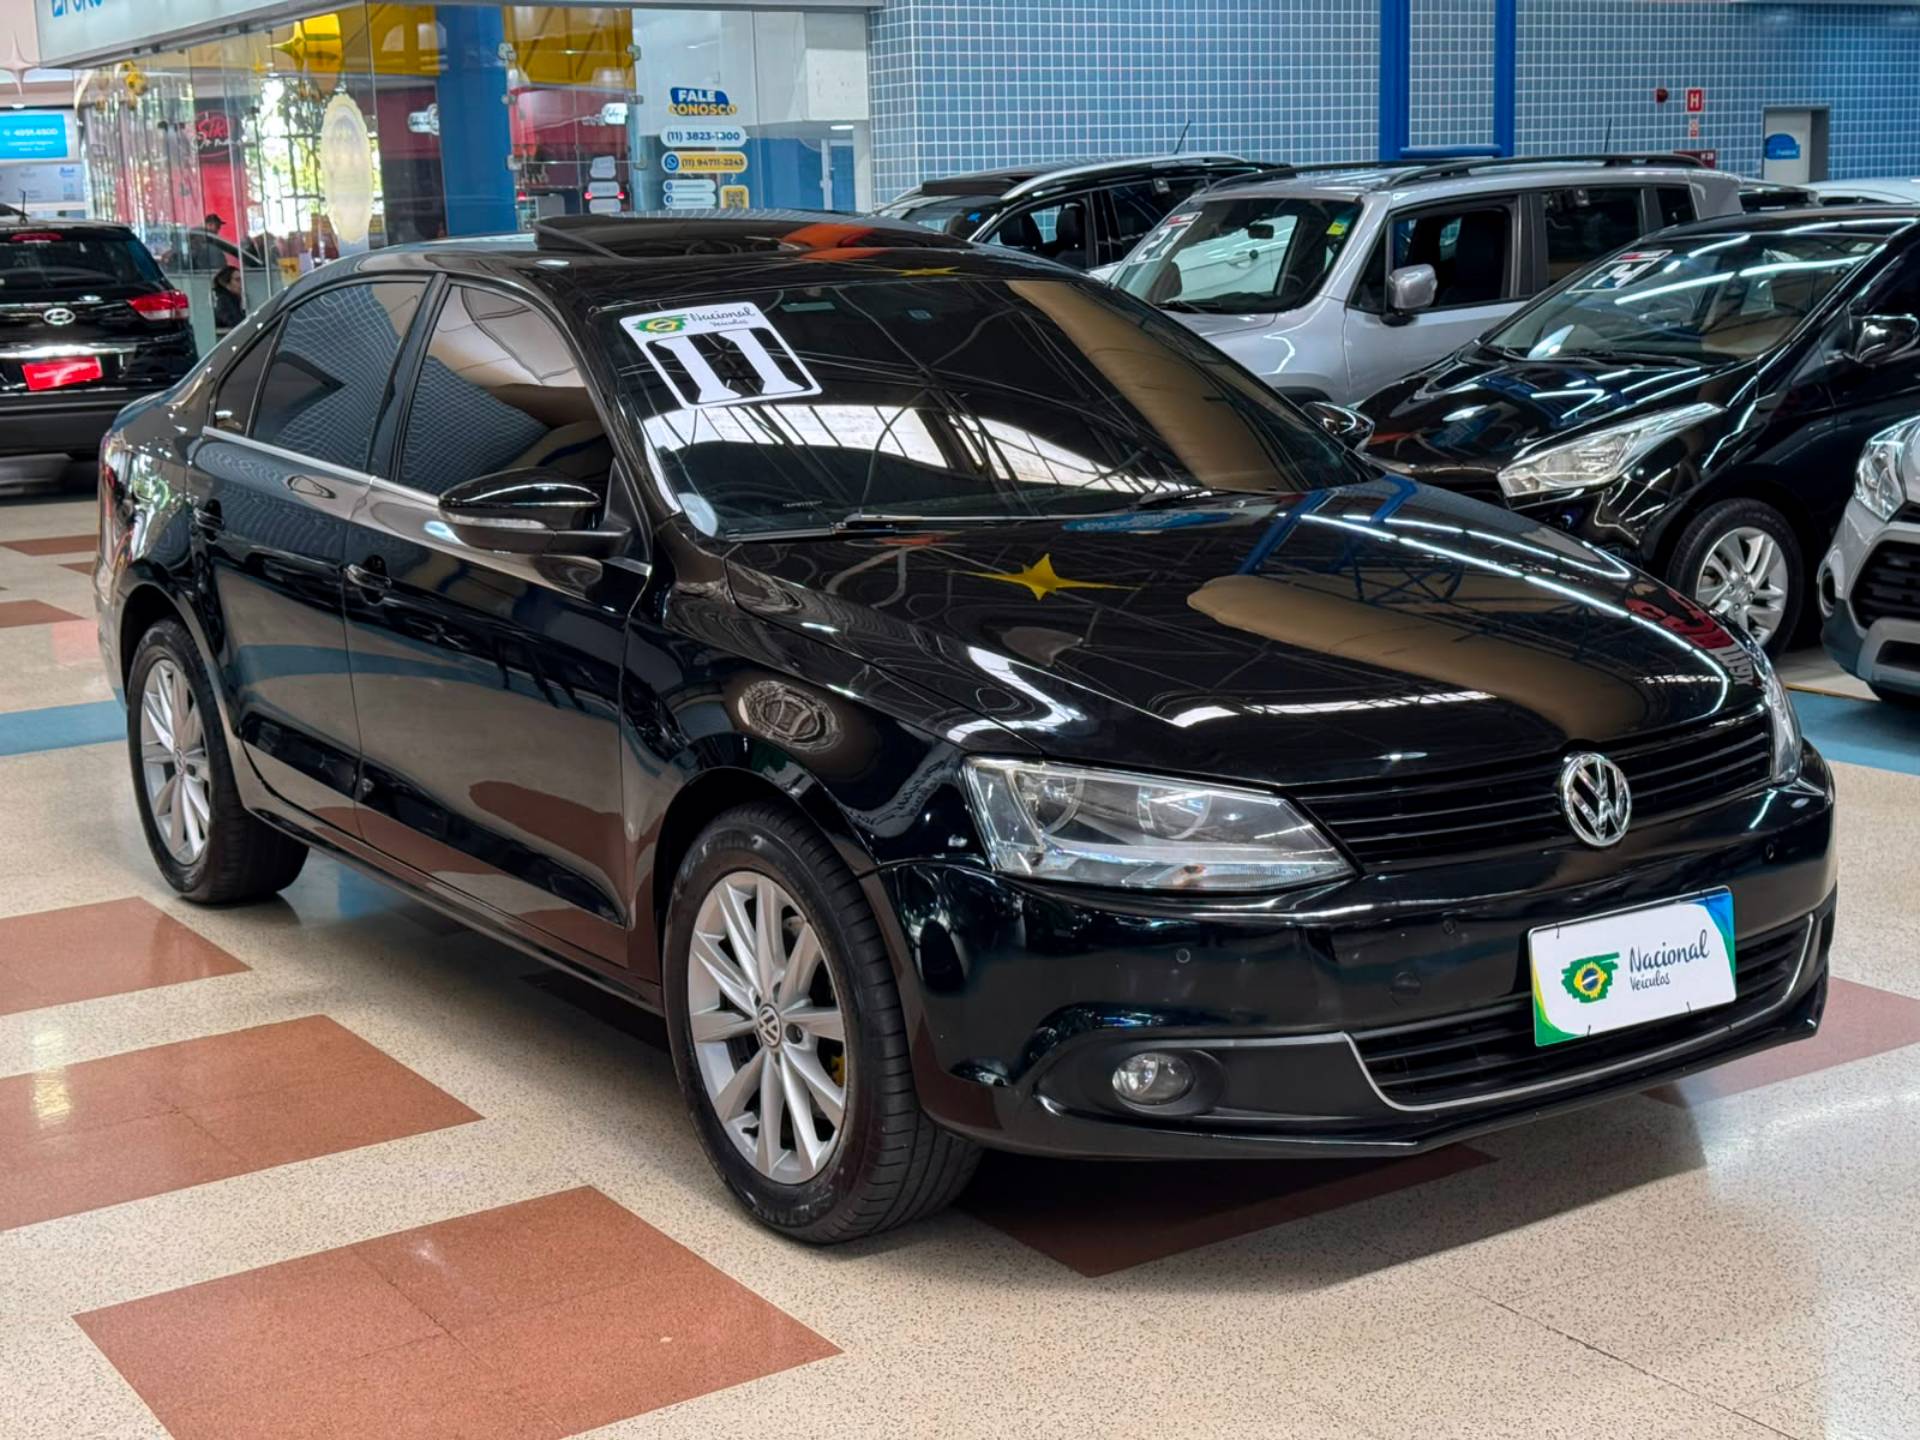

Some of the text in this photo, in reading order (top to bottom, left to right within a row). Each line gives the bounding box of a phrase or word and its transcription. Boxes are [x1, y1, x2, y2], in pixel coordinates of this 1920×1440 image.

[678, 89, 716, 102] FALE
[1689, 93, 1700, 109] H
[668, 103, 737, 115] CONOSCO
[667, 131, 683, 142] (11)
[689, 306, 756, 321] Nacional
[1629, 929, 1710, 974] Nacional
